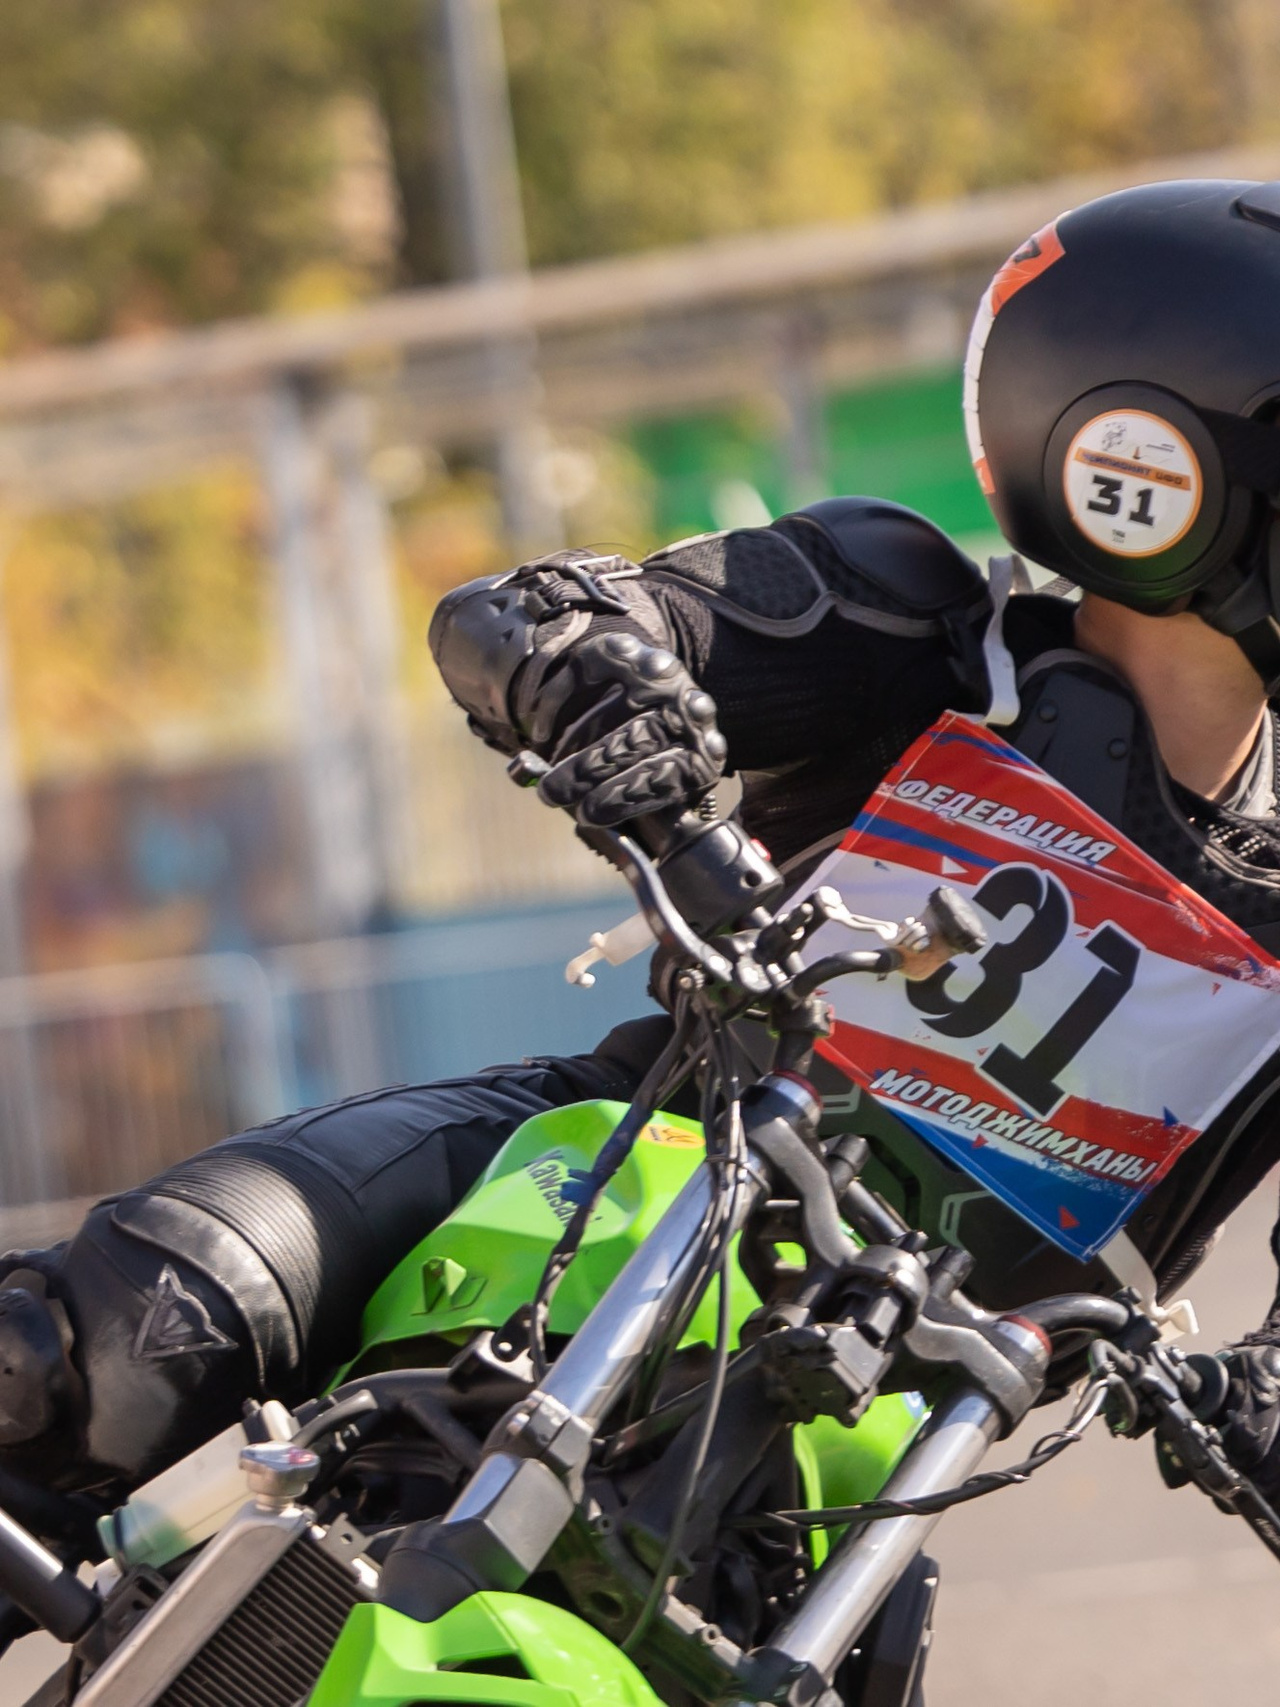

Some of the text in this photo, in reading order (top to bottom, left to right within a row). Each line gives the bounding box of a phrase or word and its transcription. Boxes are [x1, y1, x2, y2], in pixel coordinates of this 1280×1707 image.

[1087, 474, 1155, 527] 31
[895, 779, 1118, 864] ФЕДЕРАЦИЯ
[904, 866, 1142, 1117] 31
[869, 1068, 1158, 1182] МОТОДЖИМХАНЫ
